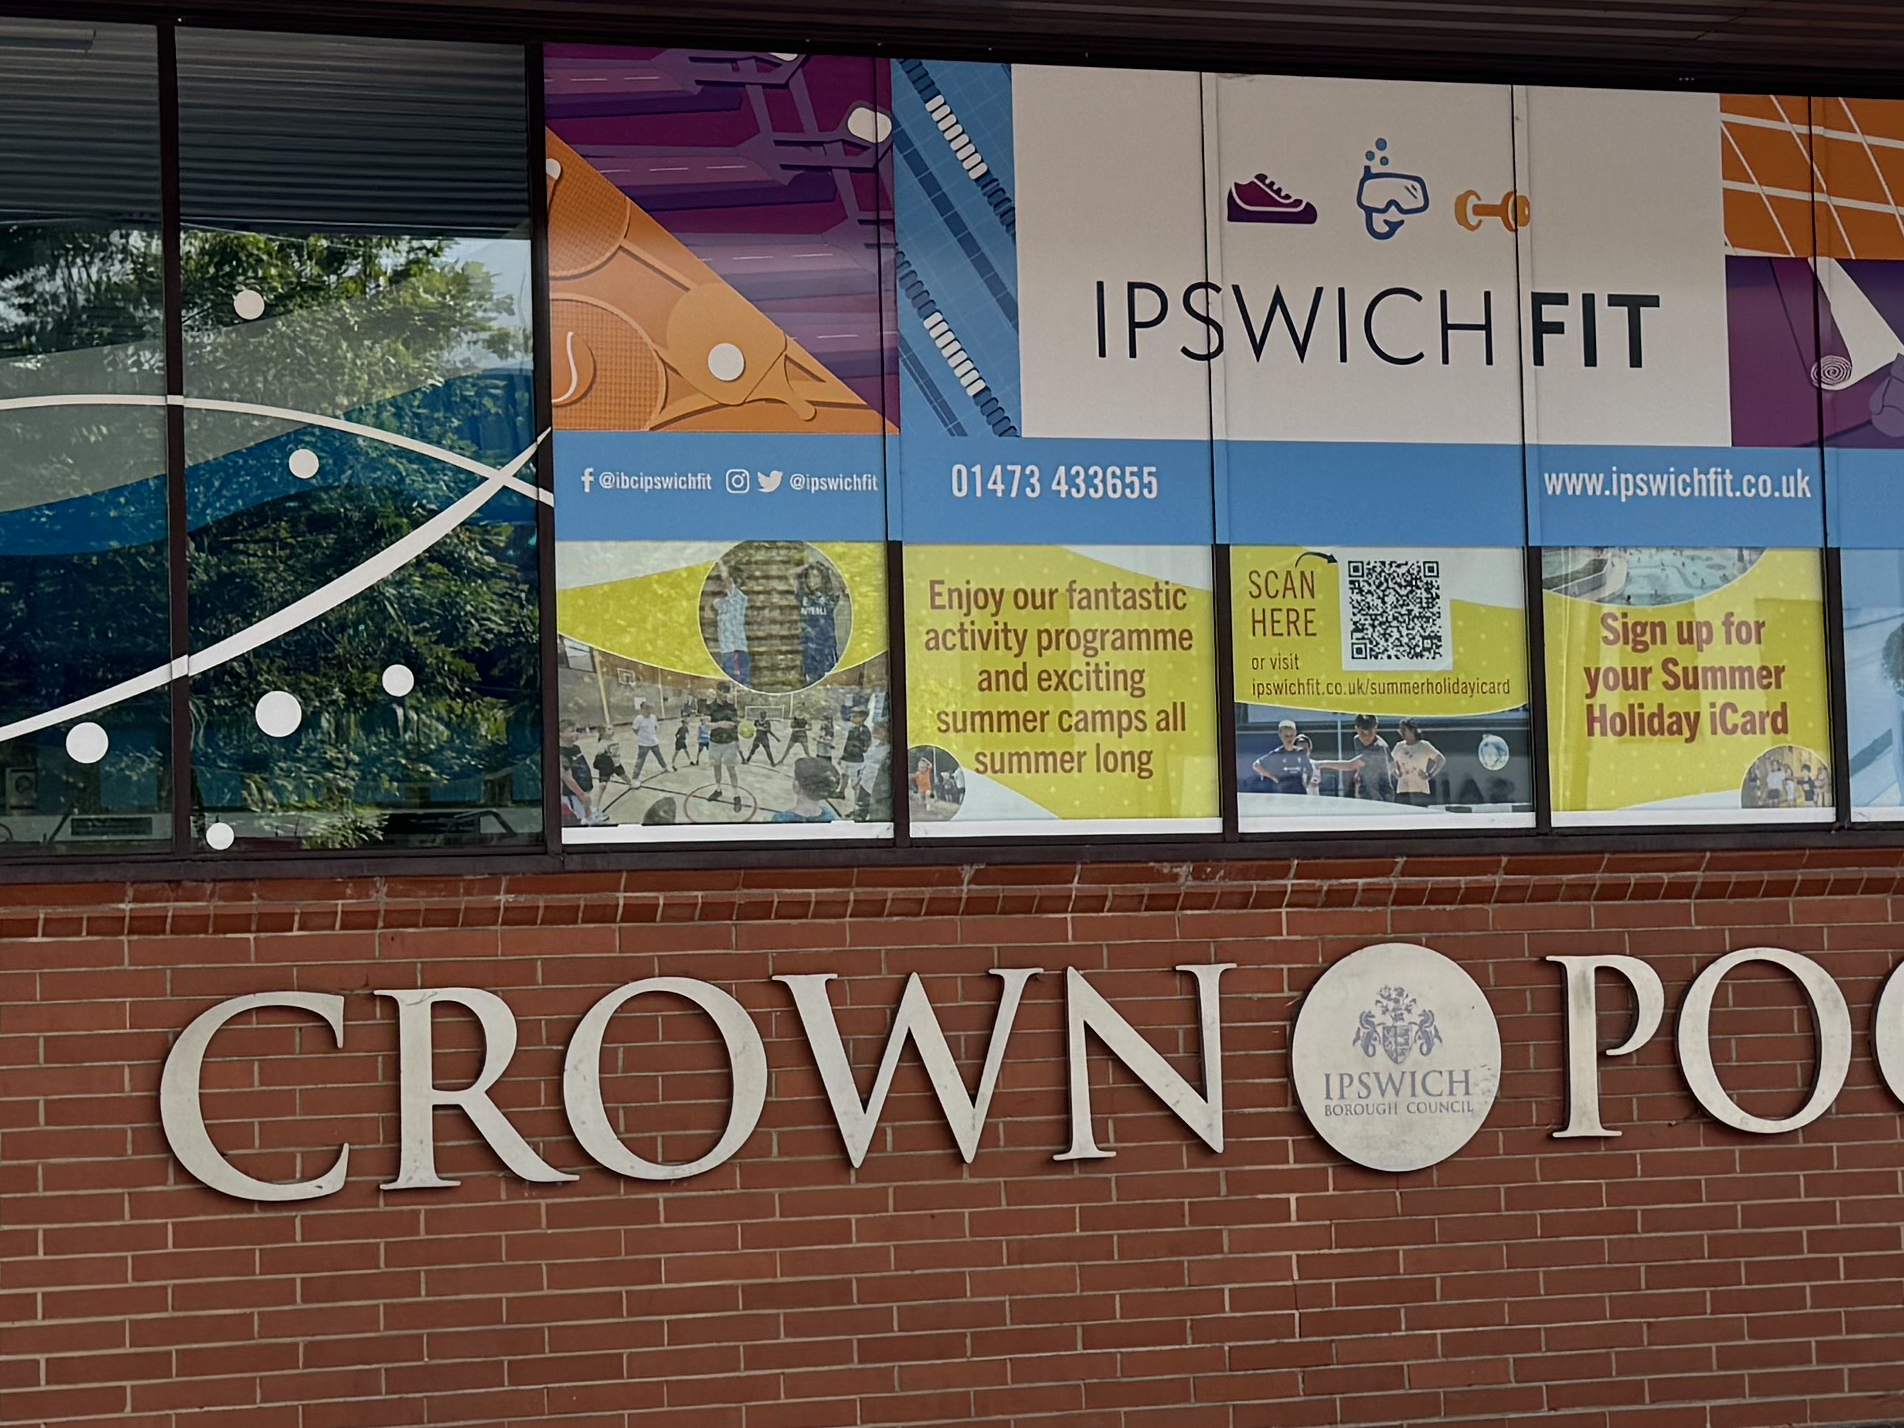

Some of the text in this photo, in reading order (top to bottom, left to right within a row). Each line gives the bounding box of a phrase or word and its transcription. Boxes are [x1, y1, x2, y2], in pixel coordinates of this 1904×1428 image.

[1096, 280, 1660, 368] IPSWICH FIT
[598, 471, 712, 492] @ibcipswichfit
[789, 473, 878, 494] @ipswichfit
[951, 464, 1158, 499] 01473 433655
[1544, 466, 1812, 502] www.ipswichfit.co.uk
[929, 579, 1187, 617] Enjoy our fantastic
[1248, 569, 1316, 599] SCAN
[924, 621, 1194, 658] activity programme
[1251, 608, 1317, 637] HERE
[1600, 611, 1766, 653] Sign up for
[977, 661, 1146, 698] and exciting
[1251, 652, 1299, 671] or visit
[1584, 657, 1786, 699] your Summer
[1252, 677, 1510, 699] ipswichfit.co.uk/summerholidayicard
[936, 701, 1187, 739] summer camps all
[1586, 701, 1789, 743] Holiday iCard
[974, 743, 1154, 779] summer long
[159, 963, 1238, 1202] CROWN
[1324, 1069, 1472, 1101] IPSWICH
[1324, 1100, 1474, 1117] BOROUGH COUNCIL
